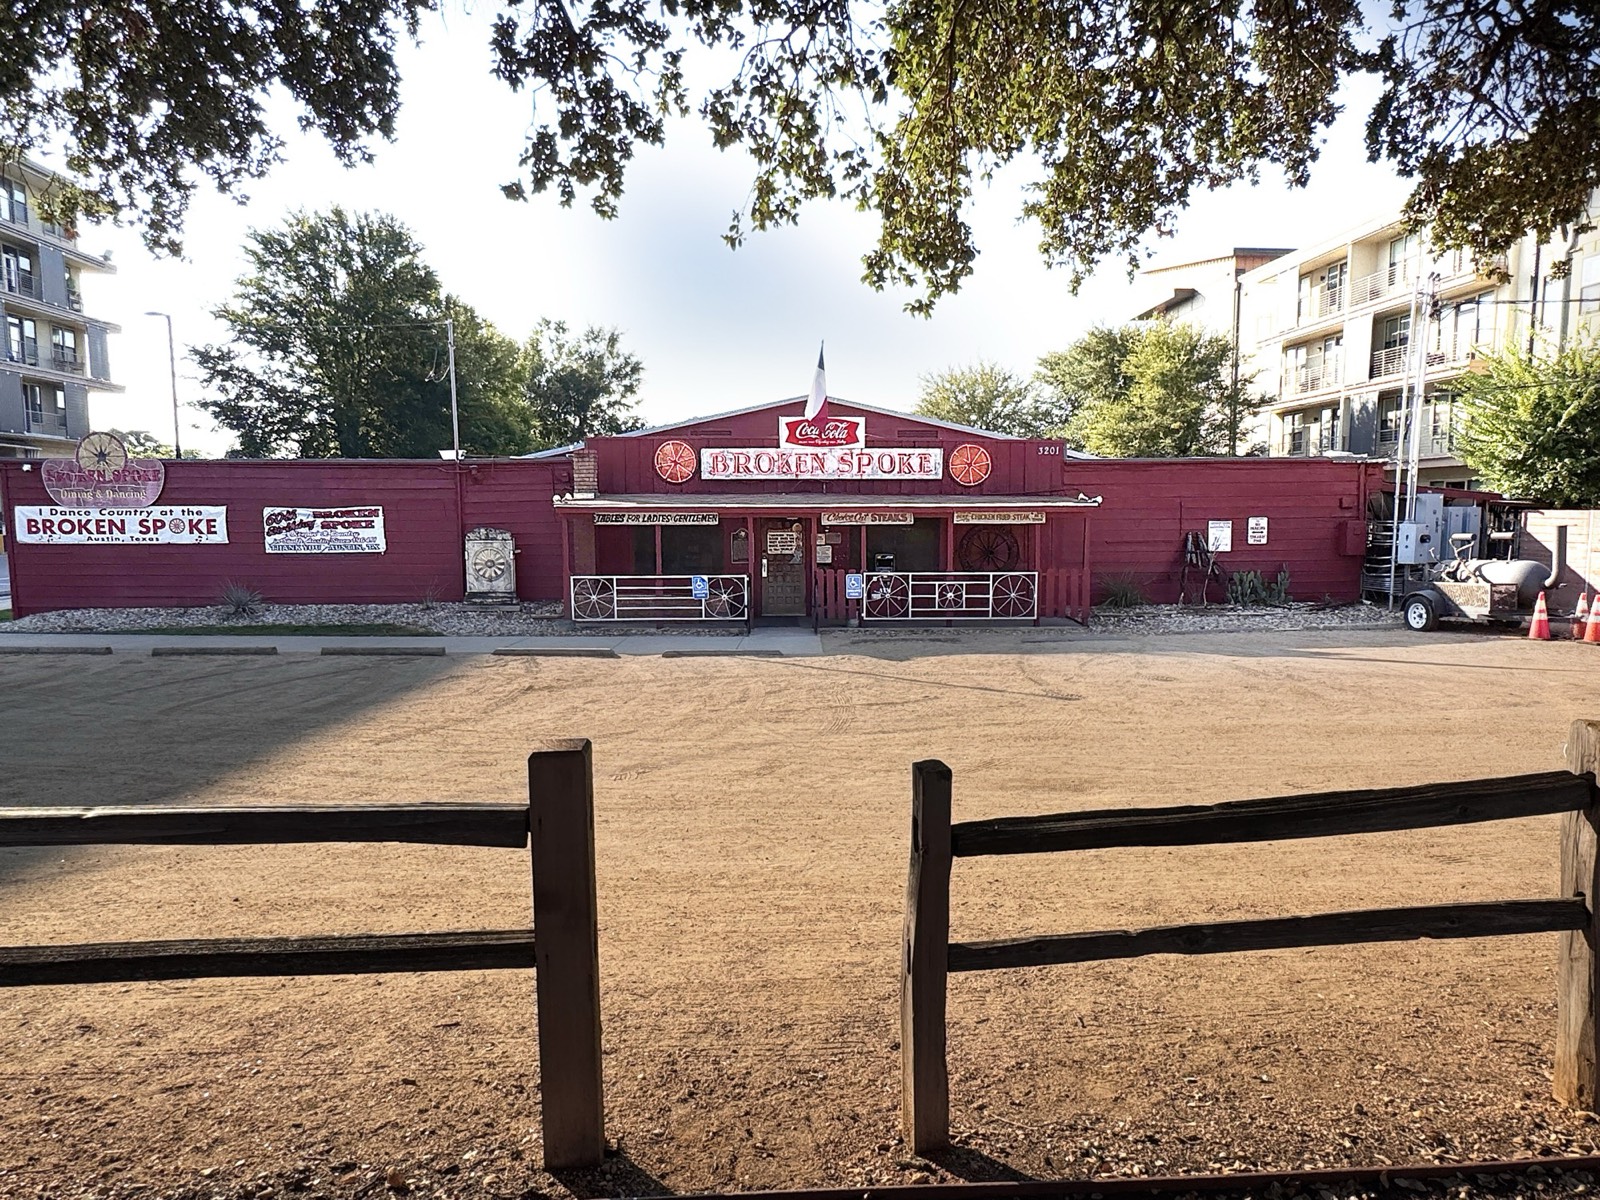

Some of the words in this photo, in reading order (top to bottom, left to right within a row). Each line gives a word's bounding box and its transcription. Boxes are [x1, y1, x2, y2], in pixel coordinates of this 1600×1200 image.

[1037, 446, 1060, 455] 3201
[709, 452, 829, 475] BROKEN
[837, 452, 934, 475] SPOKE
[112, 469, 161, 483] SPOKE
[60, 489, 94, 500] Dining
[95, 489, 103, 498] &
[105, 489, 147, 500] Dancing
[49, 508, 91, 517] Dance
[98, 508, 154, 518] Country
[159, 508, 175, 517] at
[181, 508, 203, 517] the
[312, 509, 380, 519] BROKEN
[870, 513, 908, 522] STEAKS
[970, 513, 996, 521] CHICKEN
[1012, 513, 1031, 521] STEAK
[596, 514, 626, 523] TABLES
[626, 514, 641, 523] FOR
[641, 514, 671, 523] LADIES
[26, 518, 126, 535] BROKEN
[138, 518, 218, 535] SPOKE
[320, 520, 375, 530] SPOKE
